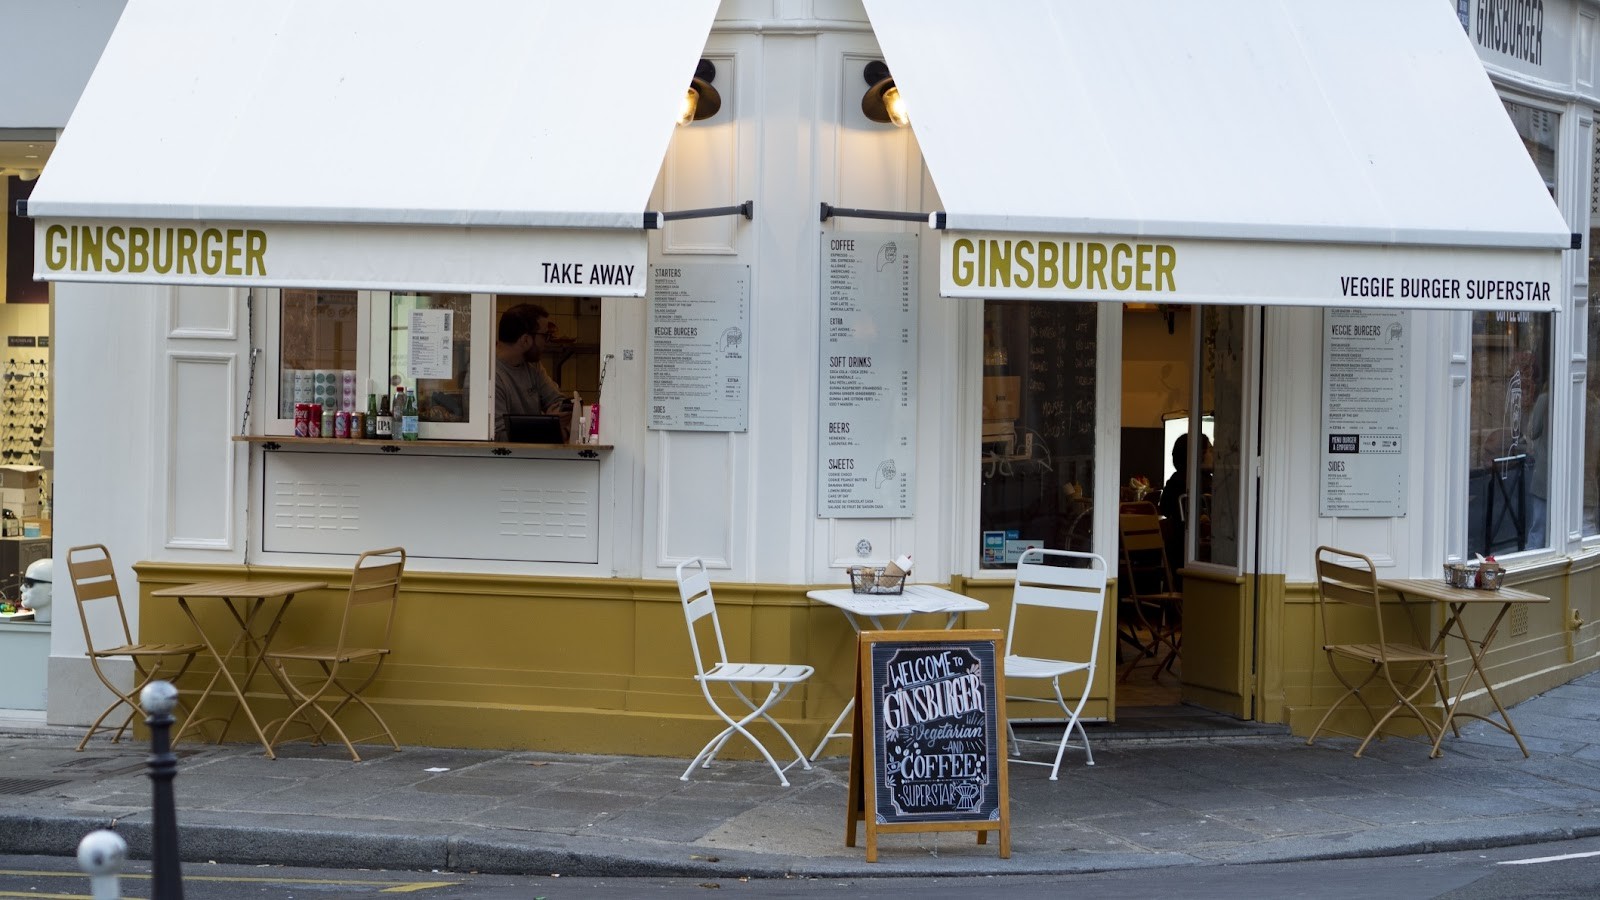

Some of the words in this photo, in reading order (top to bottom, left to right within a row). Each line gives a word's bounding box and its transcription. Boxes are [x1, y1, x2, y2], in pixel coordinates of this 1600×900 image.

[1477, 0, 1543, 66] GINSBURGER
[45, 225, 267, 277] GINSBURGER
[830, 239, 855, 251] COFFEE
[951, 239, 1177, 292] GINSBURGER
[541, 262, 583, 285] TAKE
[589, 264, 635, 286] AWAY
[655, 268, 682, 278] STARTERS
[1340, 276, 1395, 298] VEGGIE
[1401, 278, 1460, 299] BURGER
[1466, 279, 1551, 301] SUPERSTAR
[830, 317, 843, 325] EXTRA
[654, 327, 672, 336] VEGGIE
[674, 327, 698, 336] BURGERS
[1331, 324, 1351, 336] VEGGIE
[1354, 324, 1381, 336] BURGERS
[830, 356, 846, 368] SOFT
[848, 356, 872, 368] DRINKS
[653, 405, 666, 413] SIDES
[377, 420, 391, 430] IPA
[828, 422, 850, 434] BEERS
[828, 458, 854, 470] SWEETS
[1328, 461, 1345, 472] SIDES
[889, 651, 951, 688] WELCOME
[953, 656, 963, 667] TO
[883, 673, 985, 730] GINSBURGER
[910, 722, 983, 747] Vegetarian
[941, 741, 964, 754] AND
[900, 754, 977, 780] COFFEE
[900, 783, 957, 807] SUPERSTAR
